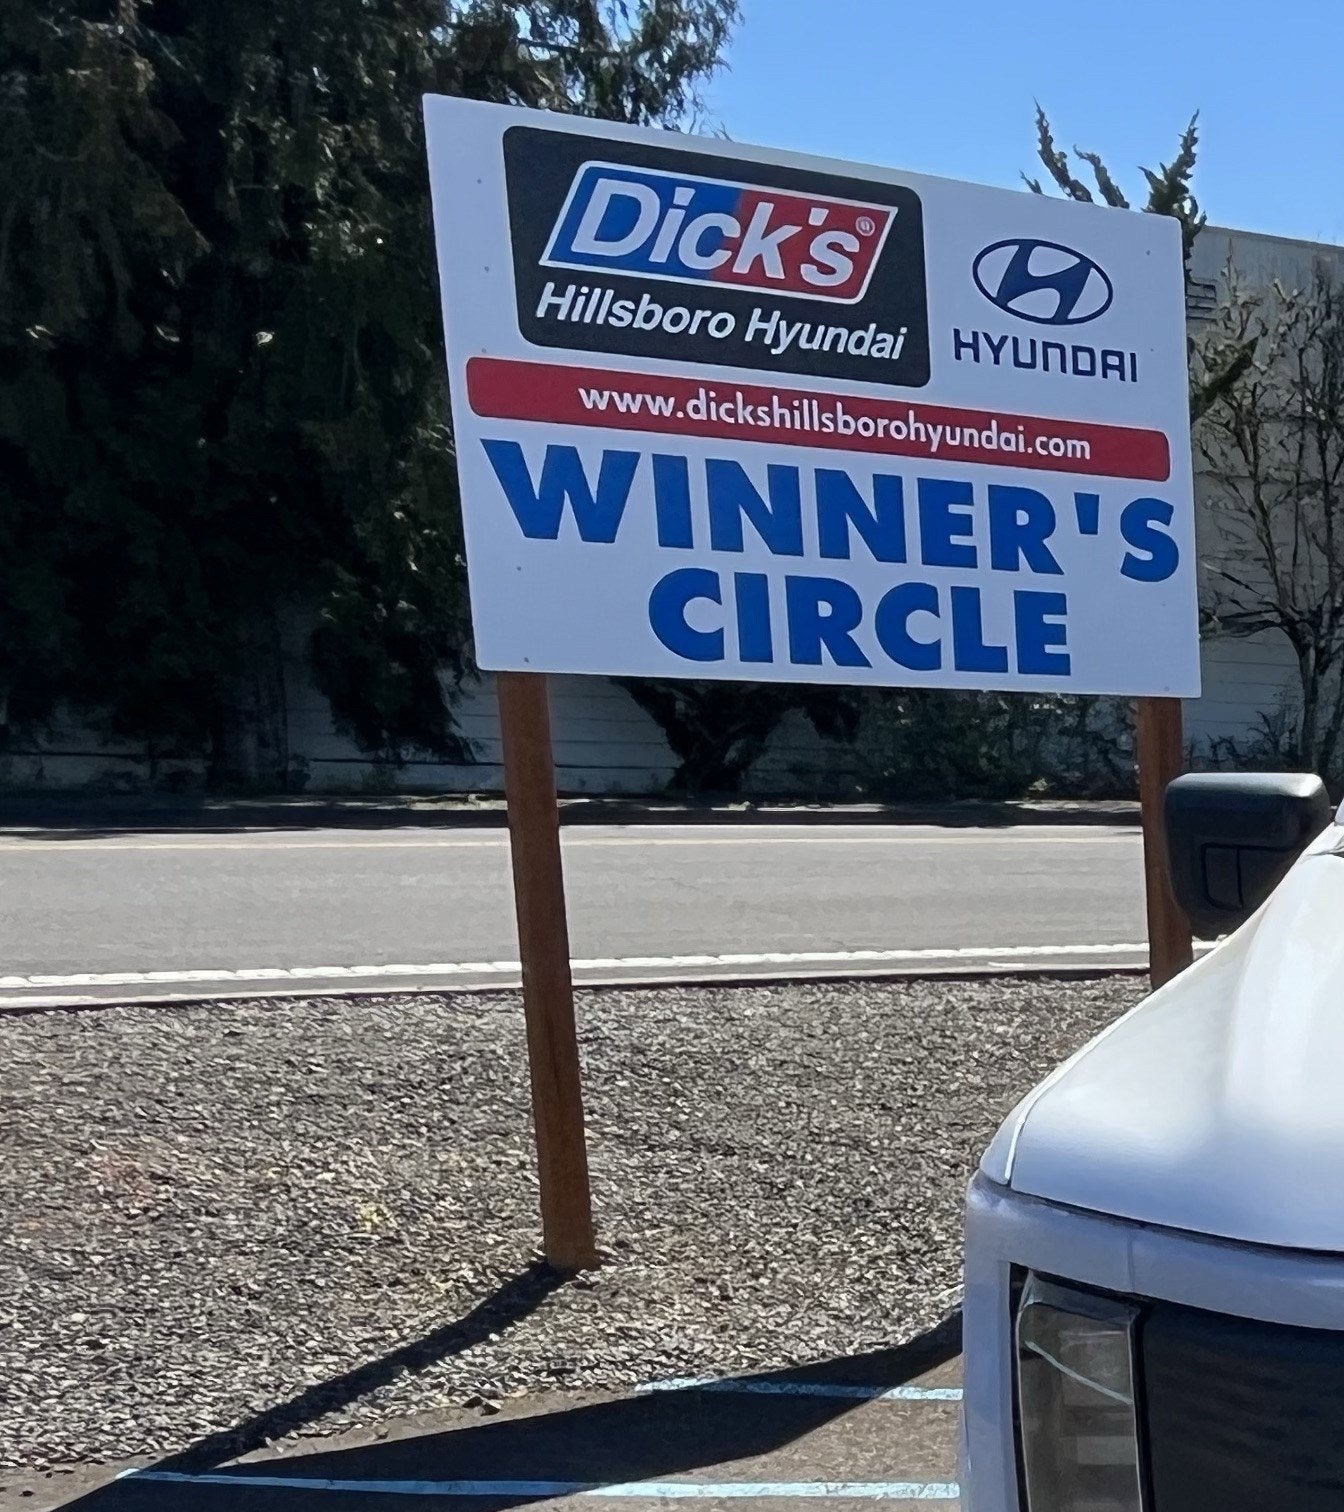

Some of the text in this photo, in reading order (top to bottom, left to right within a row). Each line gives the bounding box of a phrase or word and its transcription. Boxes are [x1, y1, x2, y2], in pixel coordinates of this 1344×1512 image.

[536, 281, 907, 360] Hillsboro Hyundai
[952, 327, 1138, 383] HYUNDAI
[577, 387, 1091, 460] www.dickshillsborohyundai.com
[479, 438, 1180, 583] WINNER'S
[648, 567, 1072, 677] CIRCLE
